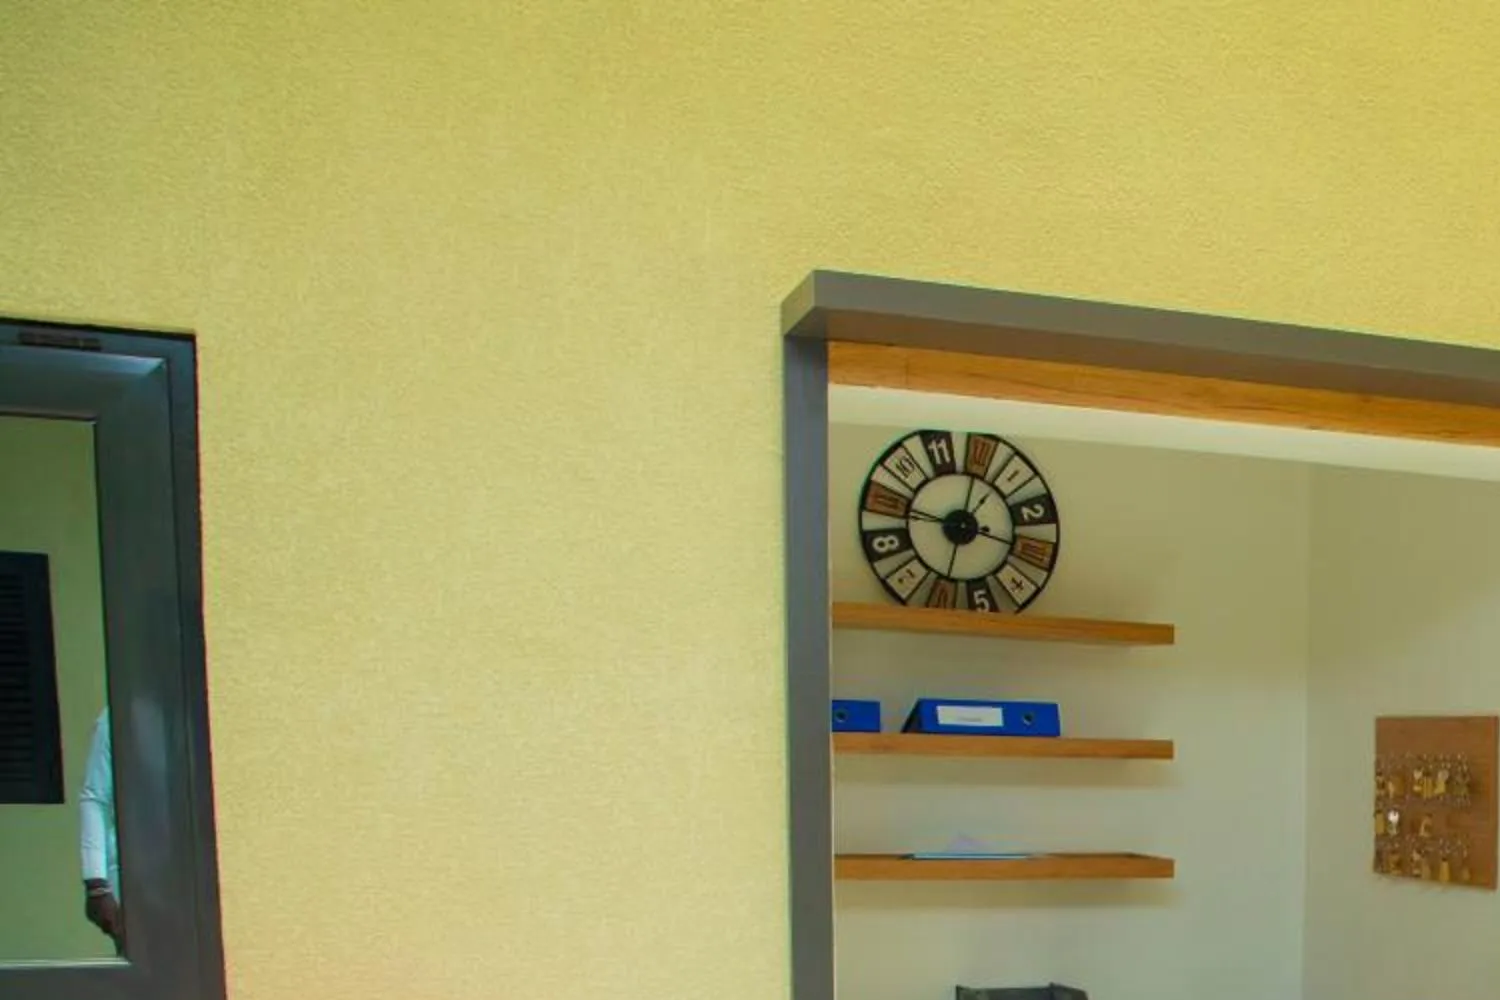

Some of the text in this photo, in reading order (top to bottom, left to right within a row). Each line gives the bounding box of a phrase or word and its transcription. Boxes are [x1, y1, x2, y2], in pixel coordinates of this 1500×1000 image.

[928, 439, 951, 465] 11
[1021, 503, 1045, 522] 2
[872, 535, 900, 554] 8
[973, 589, 990, 612] 5
